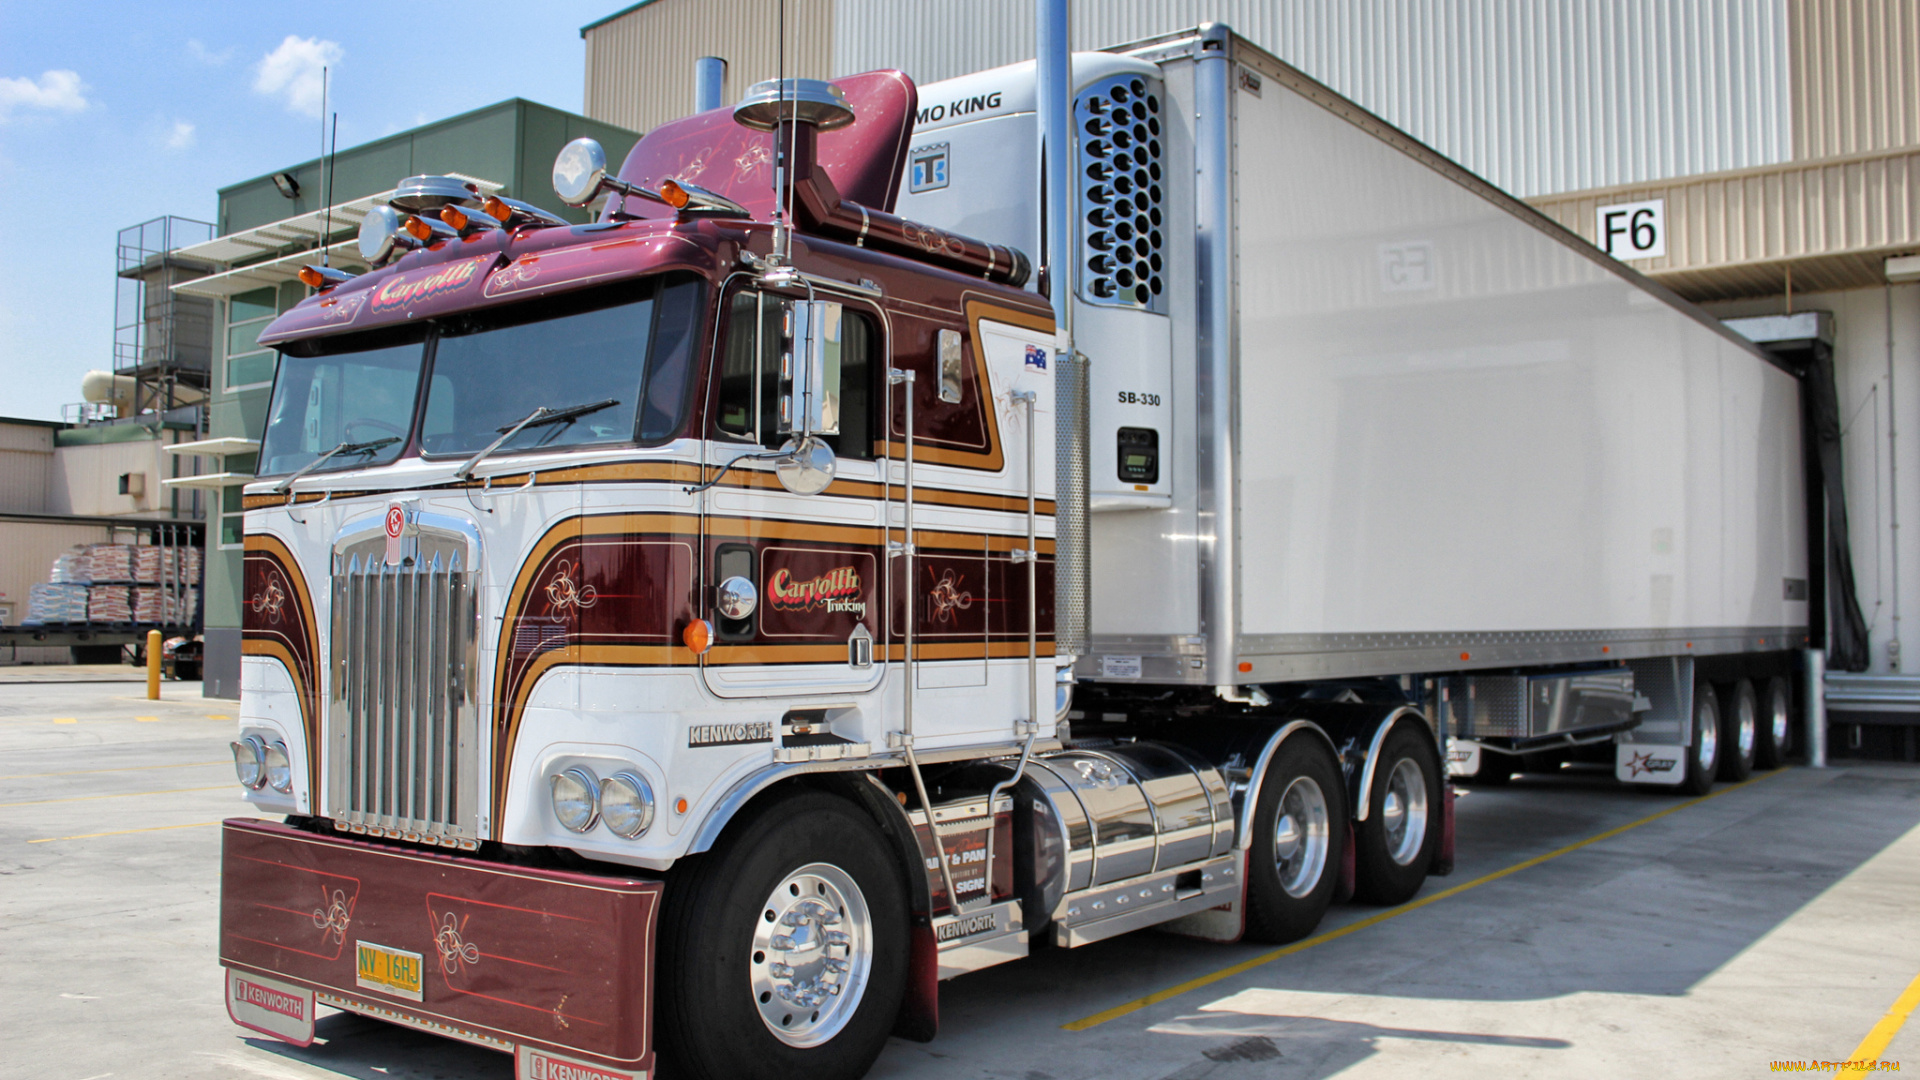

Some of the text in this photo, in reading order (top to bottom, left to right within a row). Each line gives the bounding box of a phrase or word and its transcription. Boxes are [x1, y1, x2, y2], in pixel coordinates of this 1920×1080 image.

[950, 91, 1002, 118] KING
[1604, 208, 1656, 253] F6
[1118, 391, 1160, 406] SB-330
[821, 597, 866, 620] Trucking
[690, 722, 773, 743] KENWORTH
[926, 848, 995, 869] AIT & PAN
[938, 914, 996, 940] KENWORTH
[359, 946, 376, 973] NV
[386, 954, 419, 985] 16HJ
[248, 986, 302, 1015] KENWORTH
